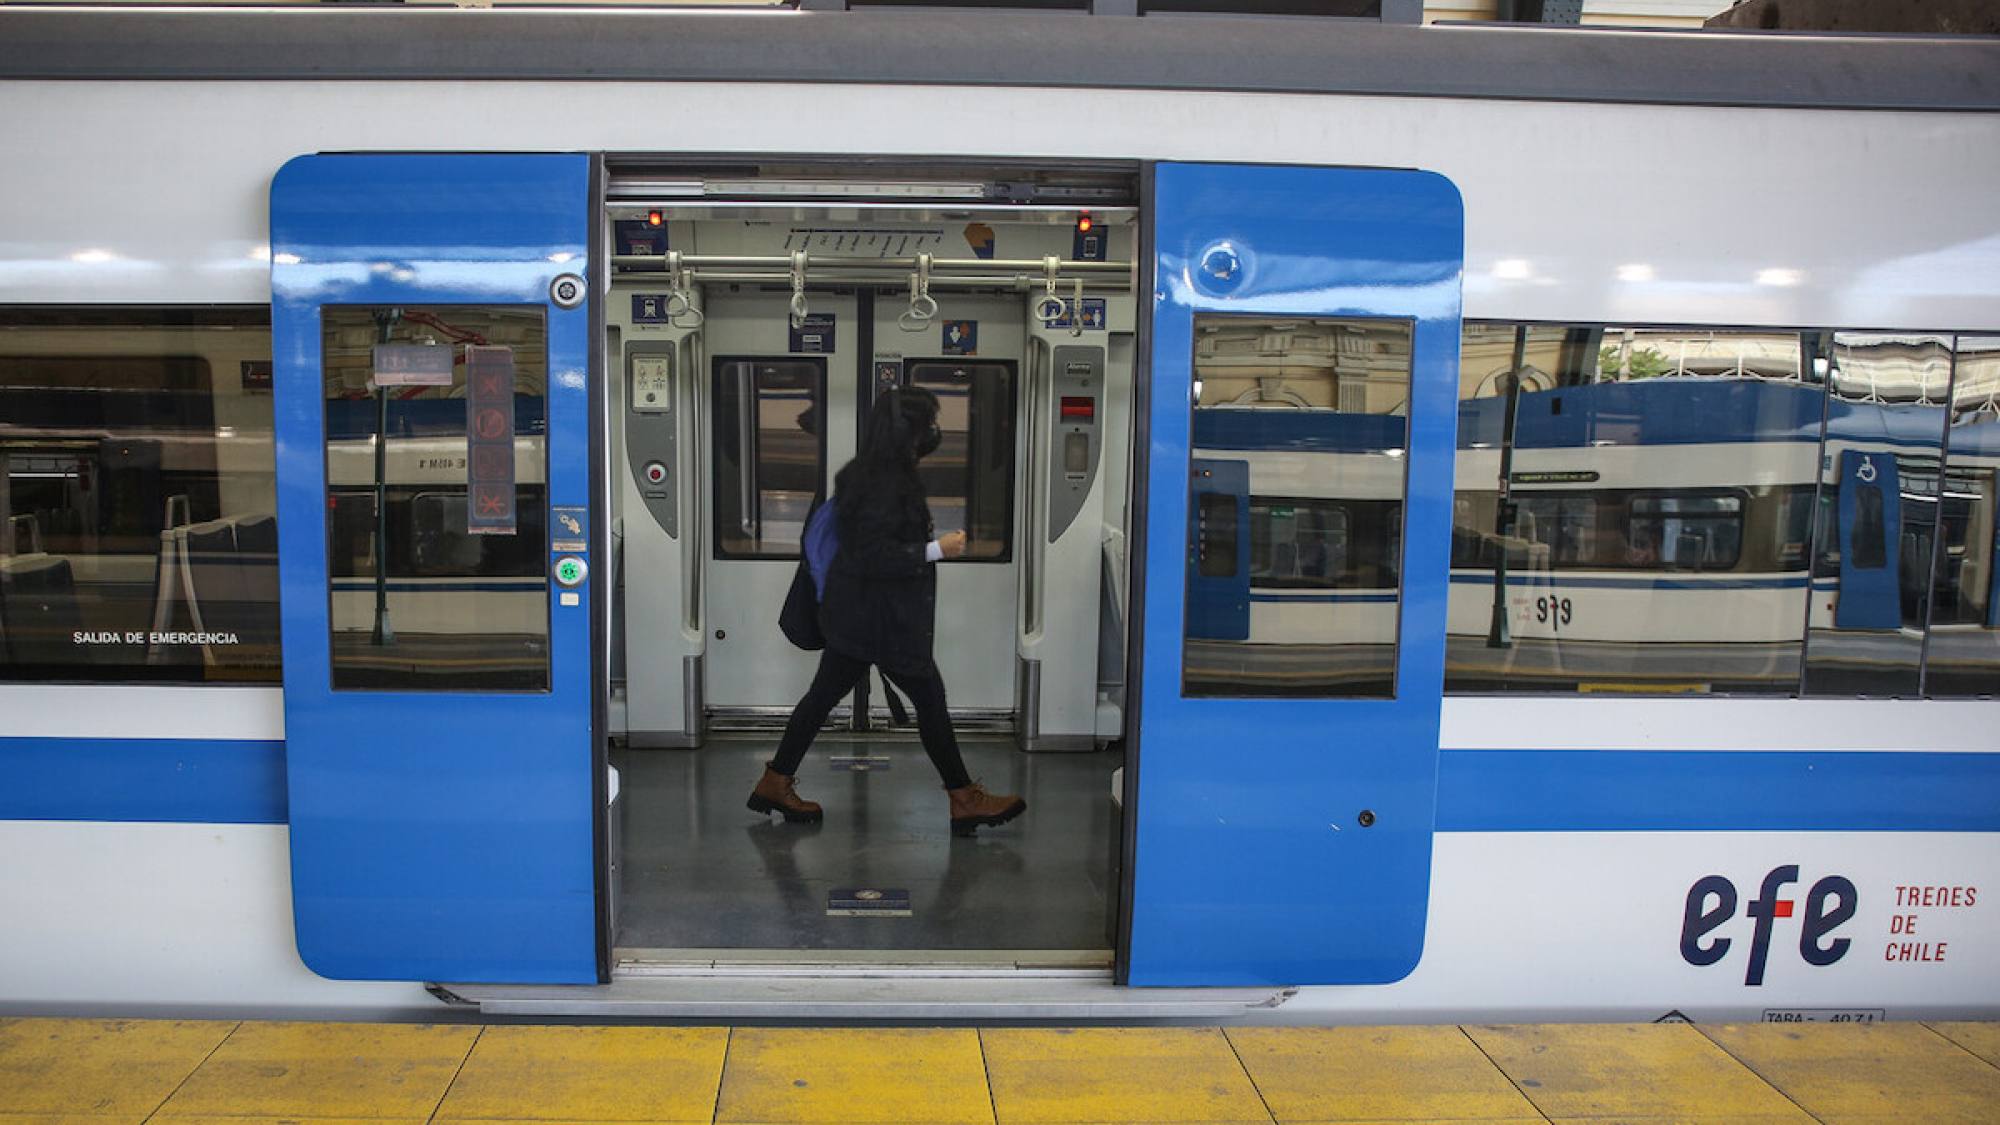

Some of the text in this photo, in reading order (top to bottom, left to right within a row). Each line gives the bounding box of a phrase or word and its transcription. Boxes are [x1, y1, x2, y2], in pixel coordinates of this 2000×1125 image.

[72, 631, 239, 645] SALIDA DE EMERGENCIA
[1895, 886, 1977, 907] TRENES
[1679, 864, 1858, 986] efe
[1890, 915, 1917, 934] DE
[1885, 942, 1948, 961] CHILE
[1767, 1012, 1802, 1023] TARA
